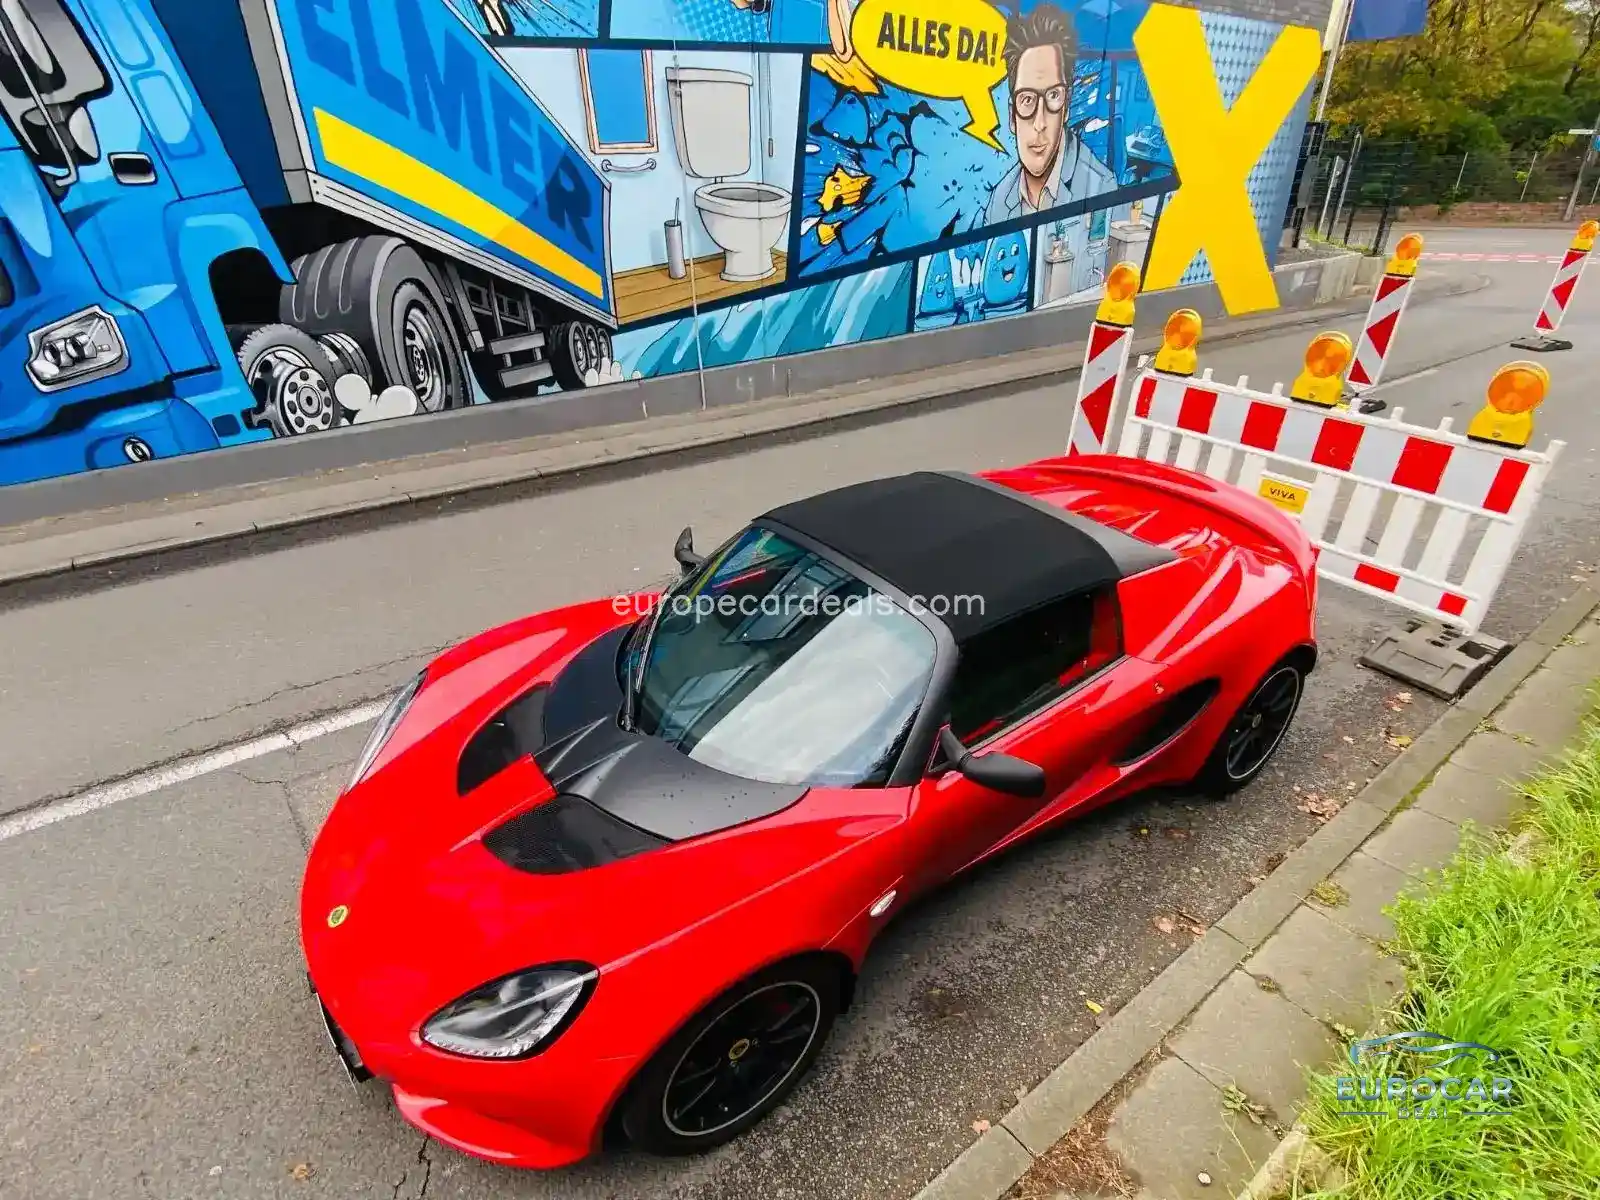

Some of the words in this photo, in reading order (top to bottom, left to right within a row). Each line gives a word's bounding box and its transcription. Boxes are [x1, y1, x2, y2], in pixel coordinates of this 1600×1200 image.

[877, 11, 951, 59] ALLES
[957, 26, 998, 67] DA!
[296, 0, 594, 254] ELMER
[1269, 487, 1296, 501] VIVA
